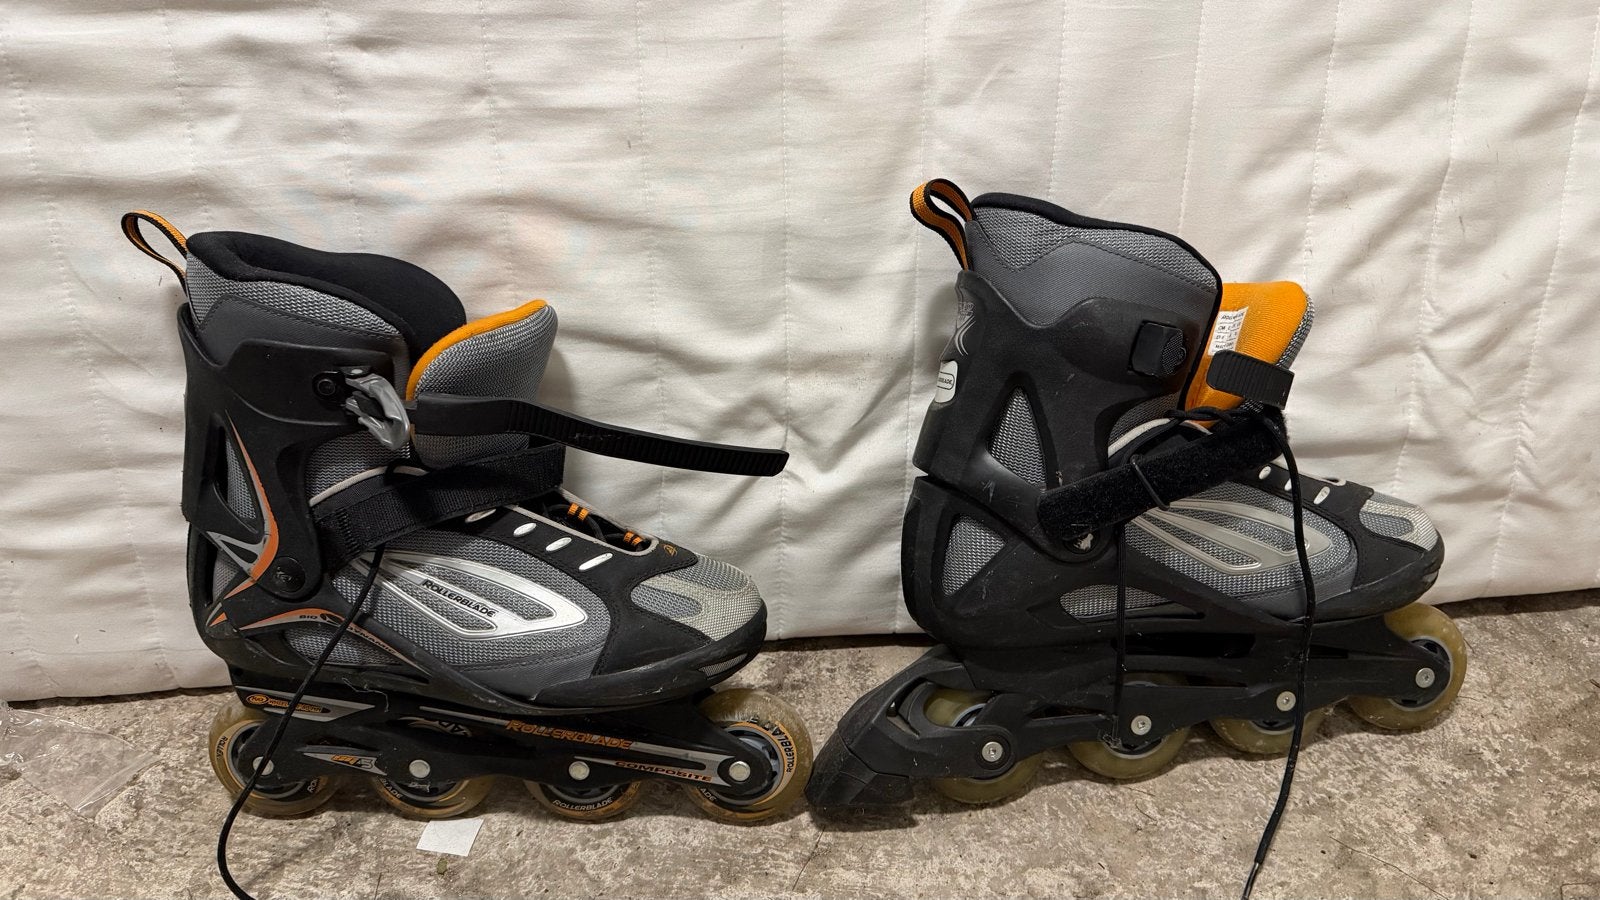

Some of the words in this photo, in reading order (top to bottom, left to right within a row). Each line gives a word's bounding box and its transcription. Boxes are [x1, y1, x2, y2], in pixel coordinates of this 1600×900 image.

[422, 580, 497, 618] ROLLERBLADE
[506, 720, 633, 749] ROLLERBLADE
[615, 760, 713, 782] COMPOSITE
[552, 796, 614, 812] ROLLERBLADE
